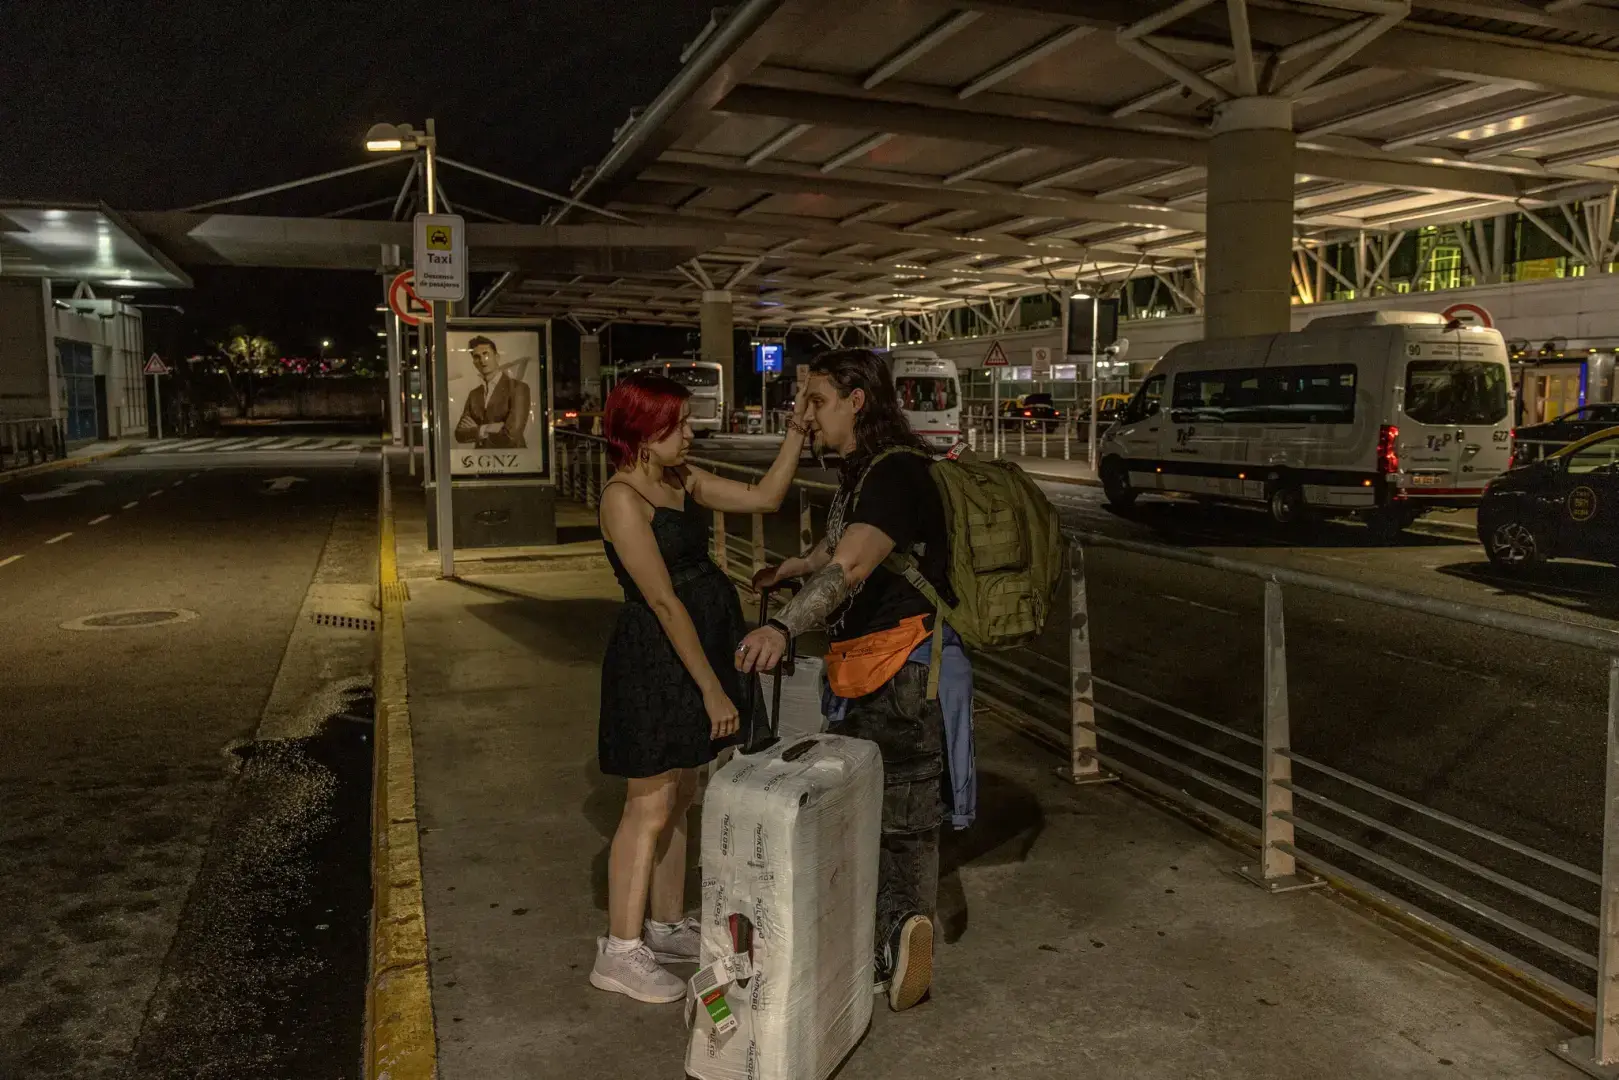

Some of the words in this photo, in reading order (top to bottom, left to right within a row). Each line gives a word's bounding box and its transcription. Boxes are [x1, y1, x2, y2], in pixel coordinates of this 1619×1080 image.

[427, 253, 452, 264] Taxi
[1408, 344, 1421, 356] 90
[1492, 430, 1509, 442] 627
[478, 454, 519, 468] GNZ
[722, 814, 730, 856] ПУЛКОВО
[714, 885, 724, 926] PULKOVO
[756, 897, 764, 939] PULKOVO
[752, 970, 762, 1011] ПУЛКОВО
[747, 1040, 756, 1080] PULKOVO
